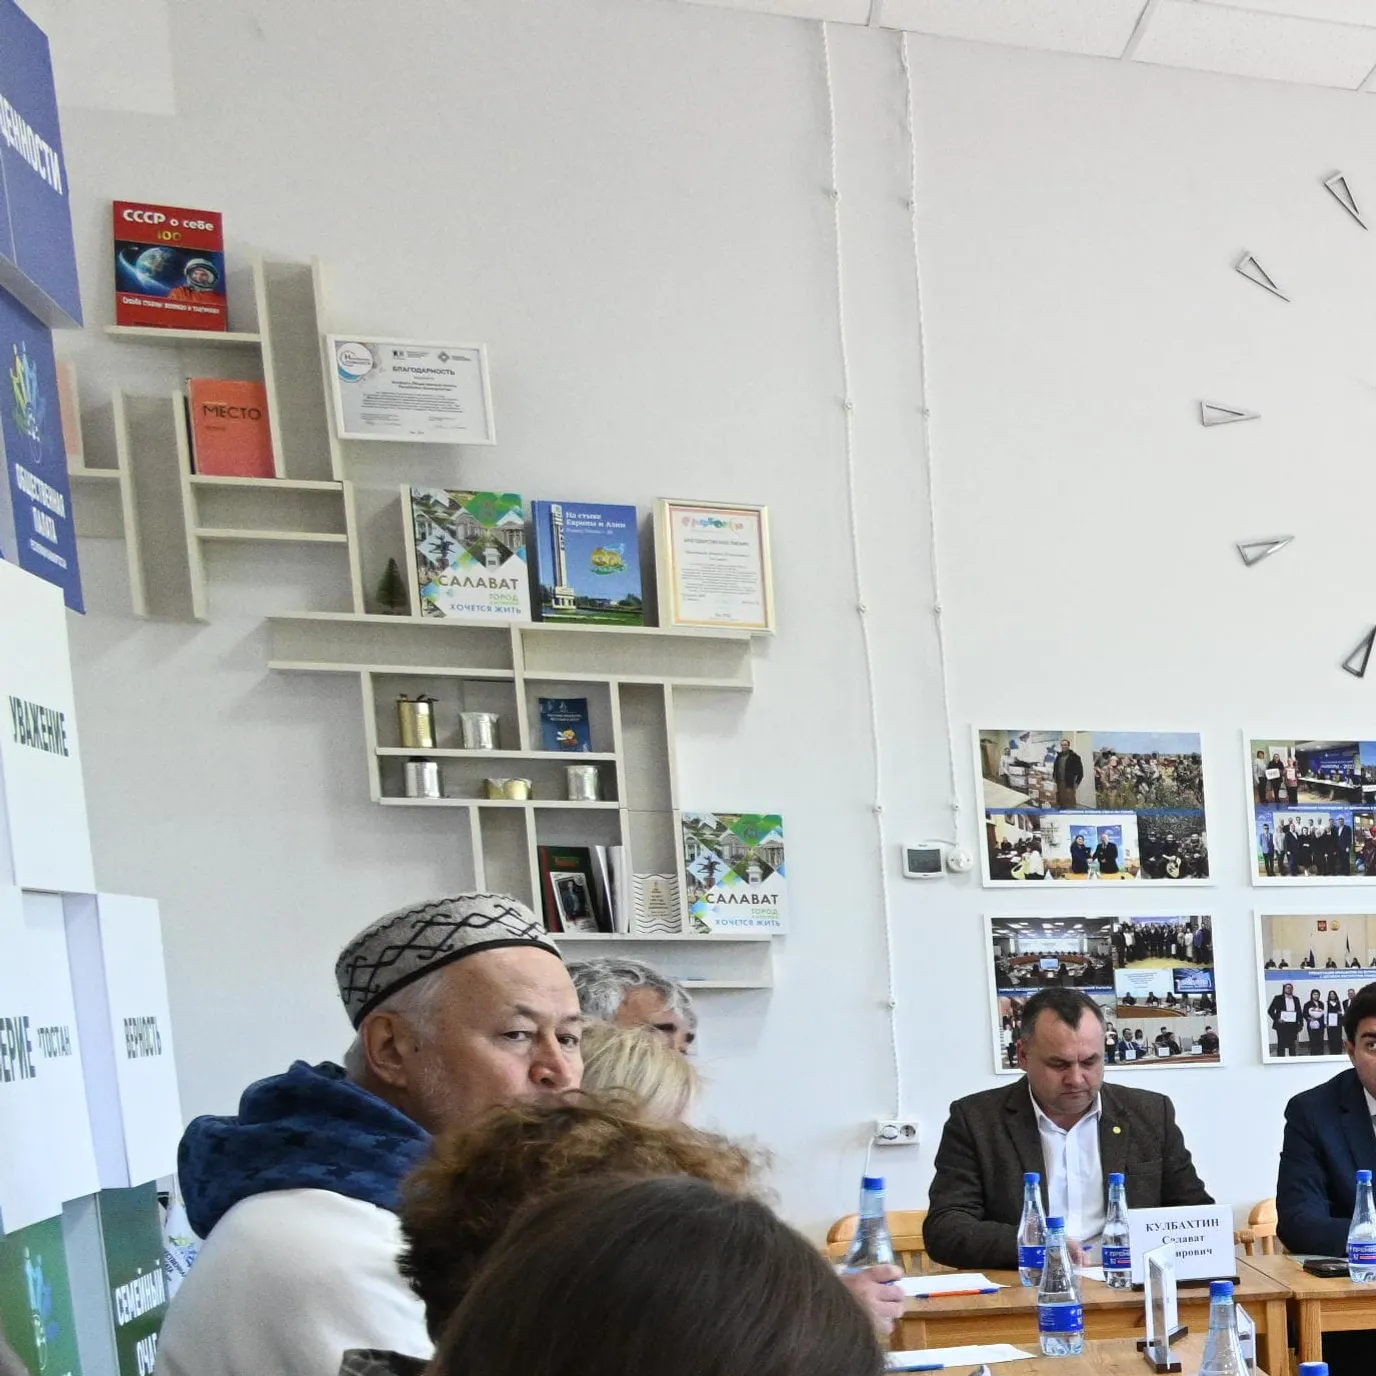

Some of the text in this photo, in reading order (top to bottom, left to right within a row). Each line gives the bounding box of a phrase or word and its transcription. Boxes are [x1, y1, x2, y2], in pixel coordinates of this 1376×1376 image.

[123, 209, 215, 232] СССР о себе
[392, 365, 456, 376] БЛАГОДАРНОСТЬ
[203, 405, 262, 420] МЕСТО
[438, 575, 519, 590] САЛАВАТ
[450, 604, 522, 614] ХОЧЕТСЯ ЖИТЬ
[8, 695, 69, 757] УВАЖЕНИЕ
[705, 893, 779, 905] САЛАВАТ
[123, 1016, 162, 1059] ВЕРНОСТЬ
[1145, 1218, 1220, 1232] КУЛБАХТИН
[1175, 1247, 1213, 1259] ирович
[115, 1259, 167, 1326] СЕМЕЙНЫЙ
